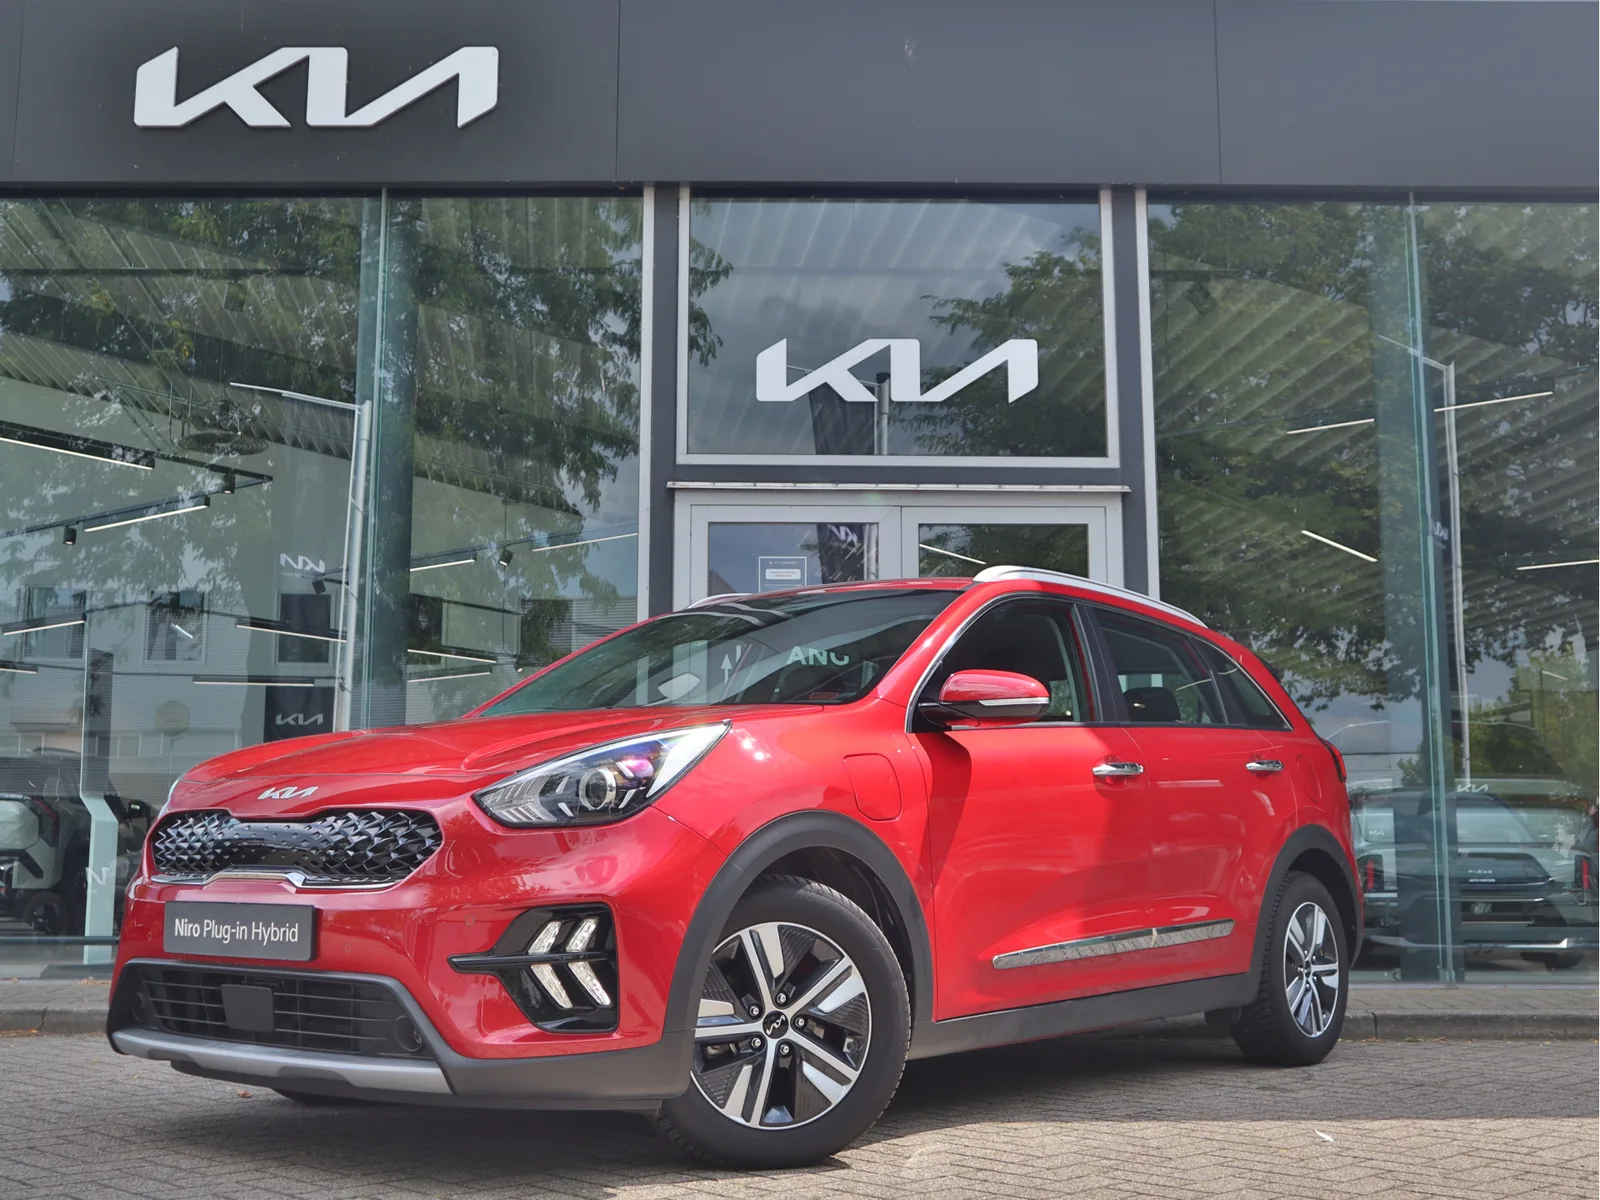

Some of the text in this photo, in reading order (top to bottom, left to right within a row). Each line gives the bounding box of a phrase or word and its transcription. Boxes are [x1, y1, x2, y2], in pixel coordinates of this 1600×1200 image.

[134, 46, 499, 129] KIA
[756, 338, 1039, 403] KIA
[276, 713, 324, 726] KIA
[257, 786, 319, 800] KIA
[174, 918, 299, 946] Niro Plug-in Hybrid
